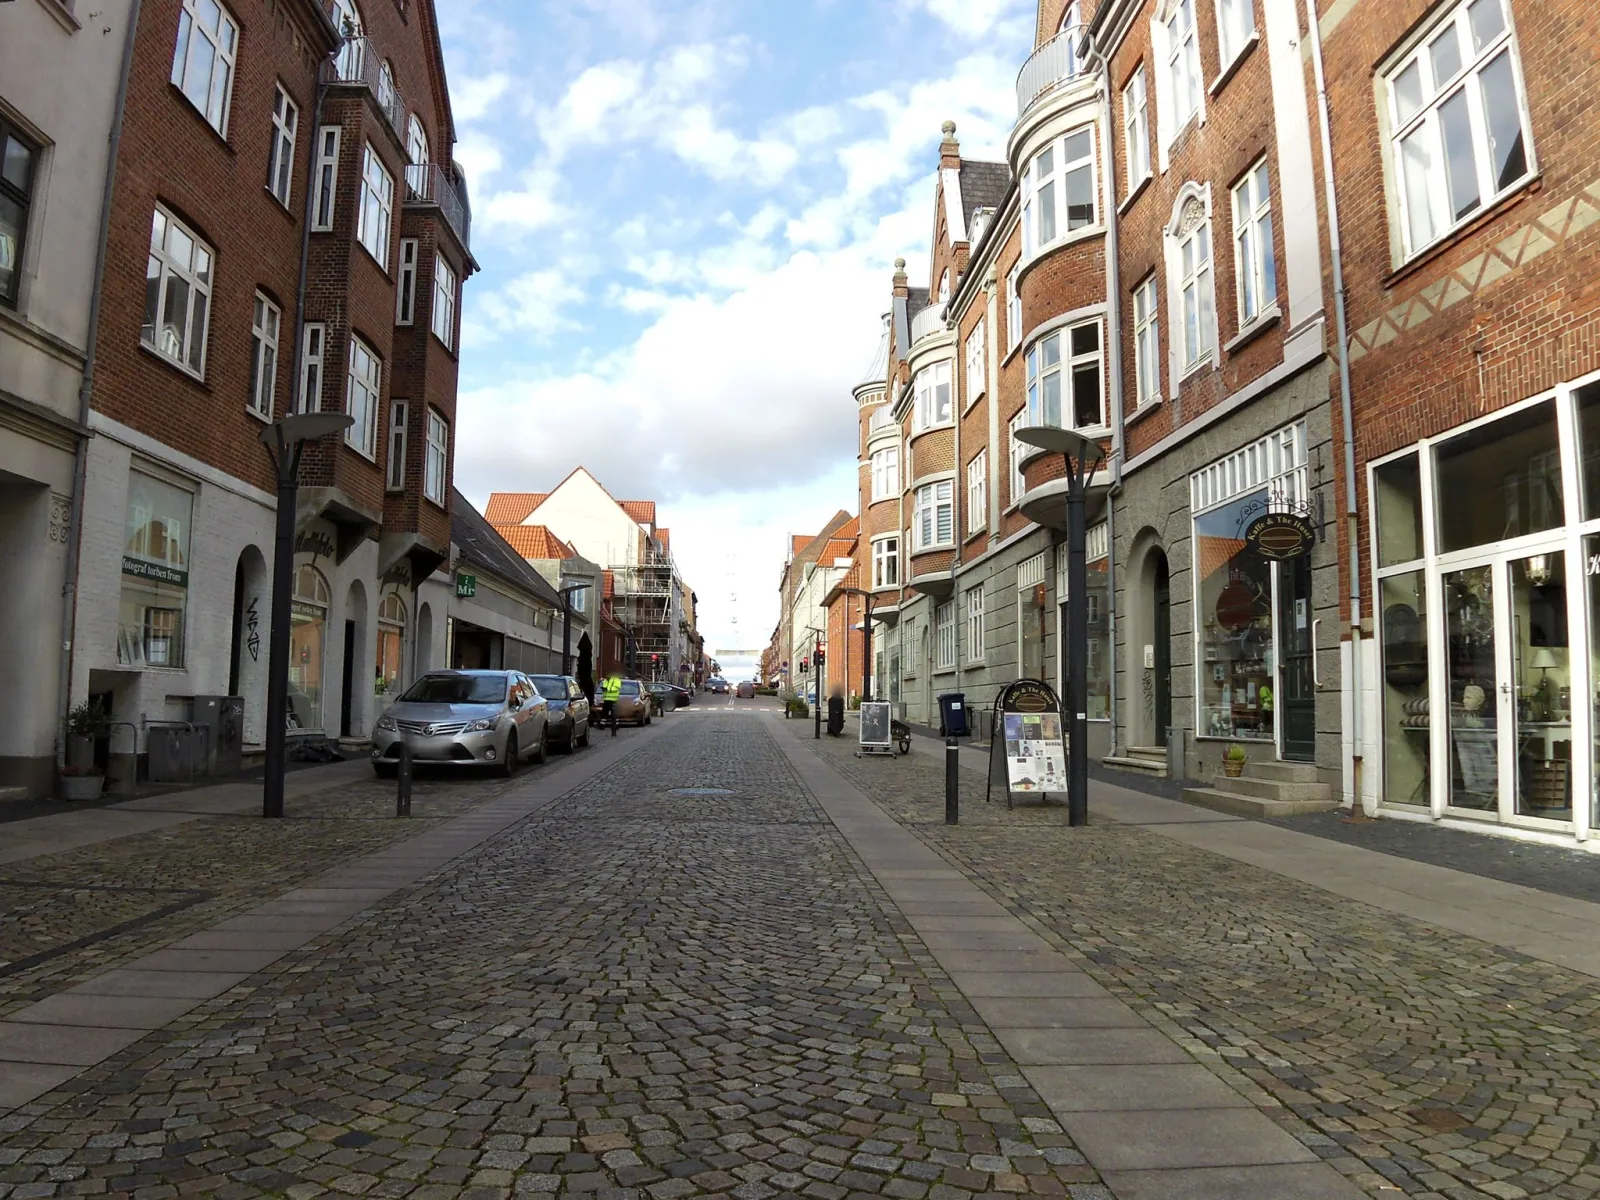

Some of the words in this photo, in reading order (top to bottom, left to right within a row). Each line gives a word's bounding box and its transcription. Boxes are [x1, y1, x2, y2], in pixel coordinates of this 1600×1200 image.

[1247, 521, 1266, 540] Kaffe
[1266, 517, 1274, 525] &
[1276, 516, 1291, 524] The
[1293, 520, 1313, 540] Huset
[122, 558, 148, 574] fotograf
[147, 566, 167, 579] torben
